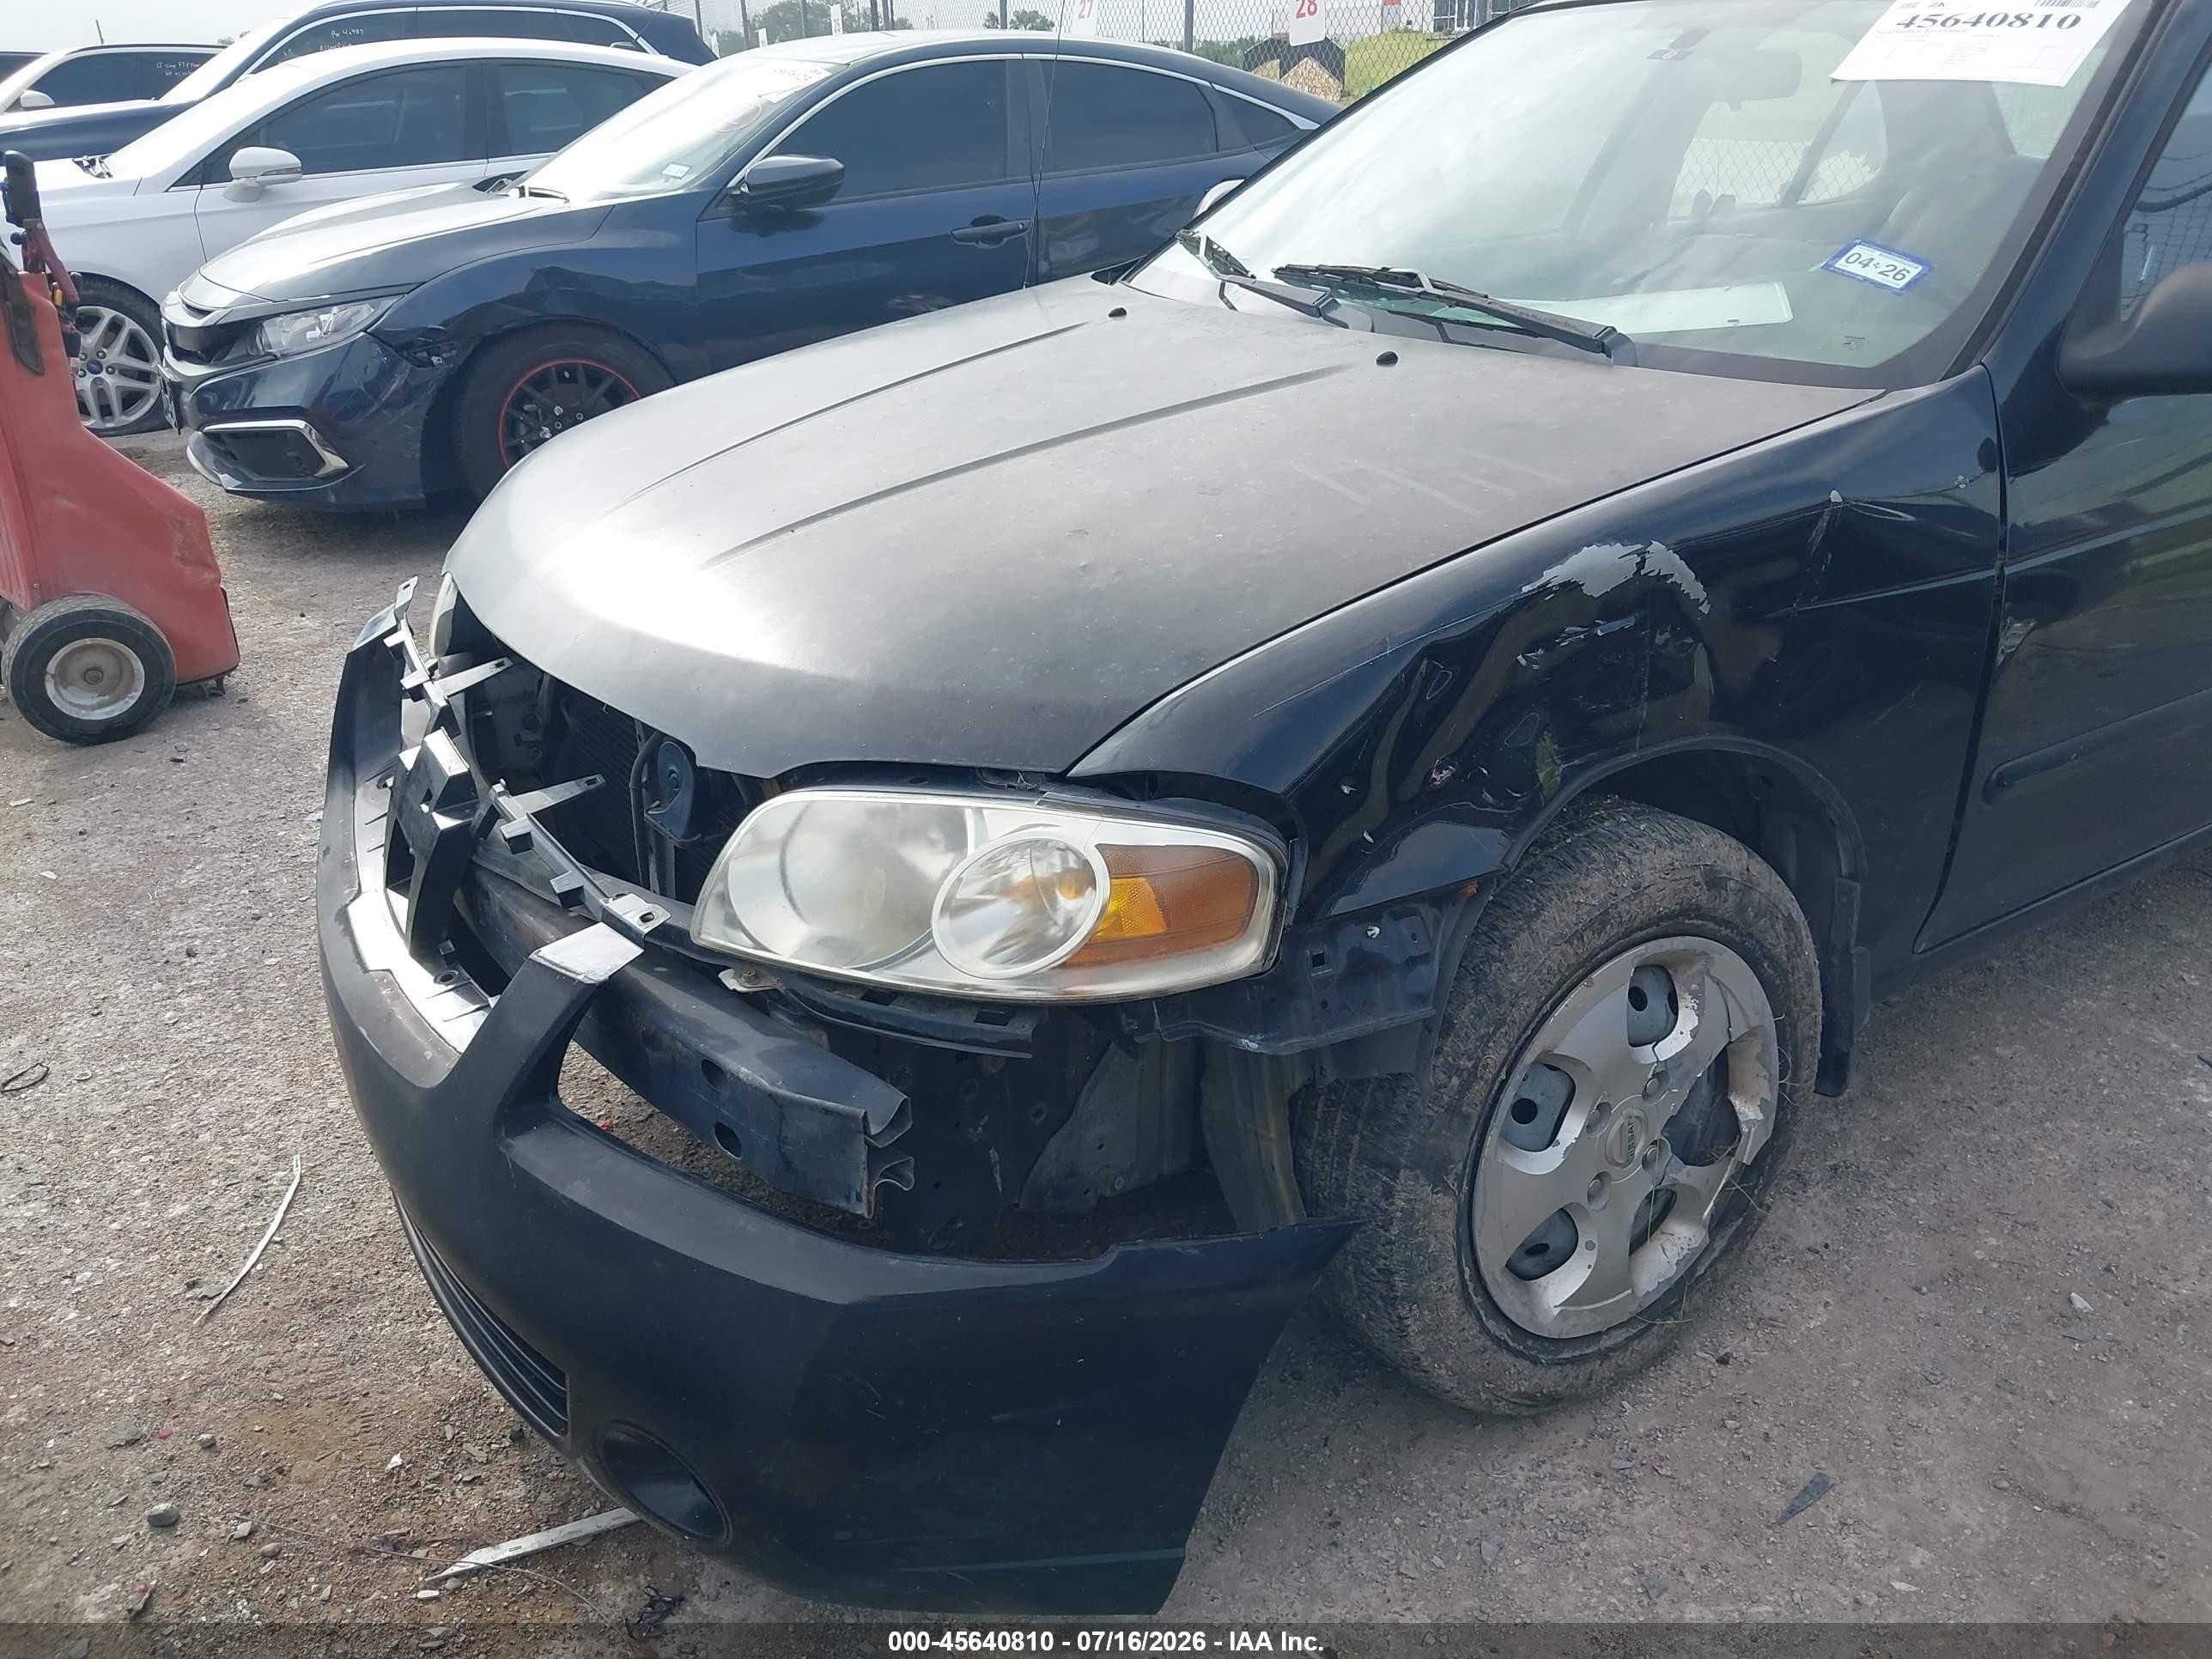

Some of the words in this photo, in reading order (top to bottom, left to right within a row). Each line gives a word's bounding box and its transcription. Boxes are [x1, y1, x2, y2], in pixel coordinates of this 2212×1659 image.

[1078, 0, 1094, 19] 27
[1296, 0, 1317, 19] 28
[1896, 12, 2081, 30] 45640810
[1844, 252, 1875, 269] 04
[1877, 264, 1911, 281] 26
